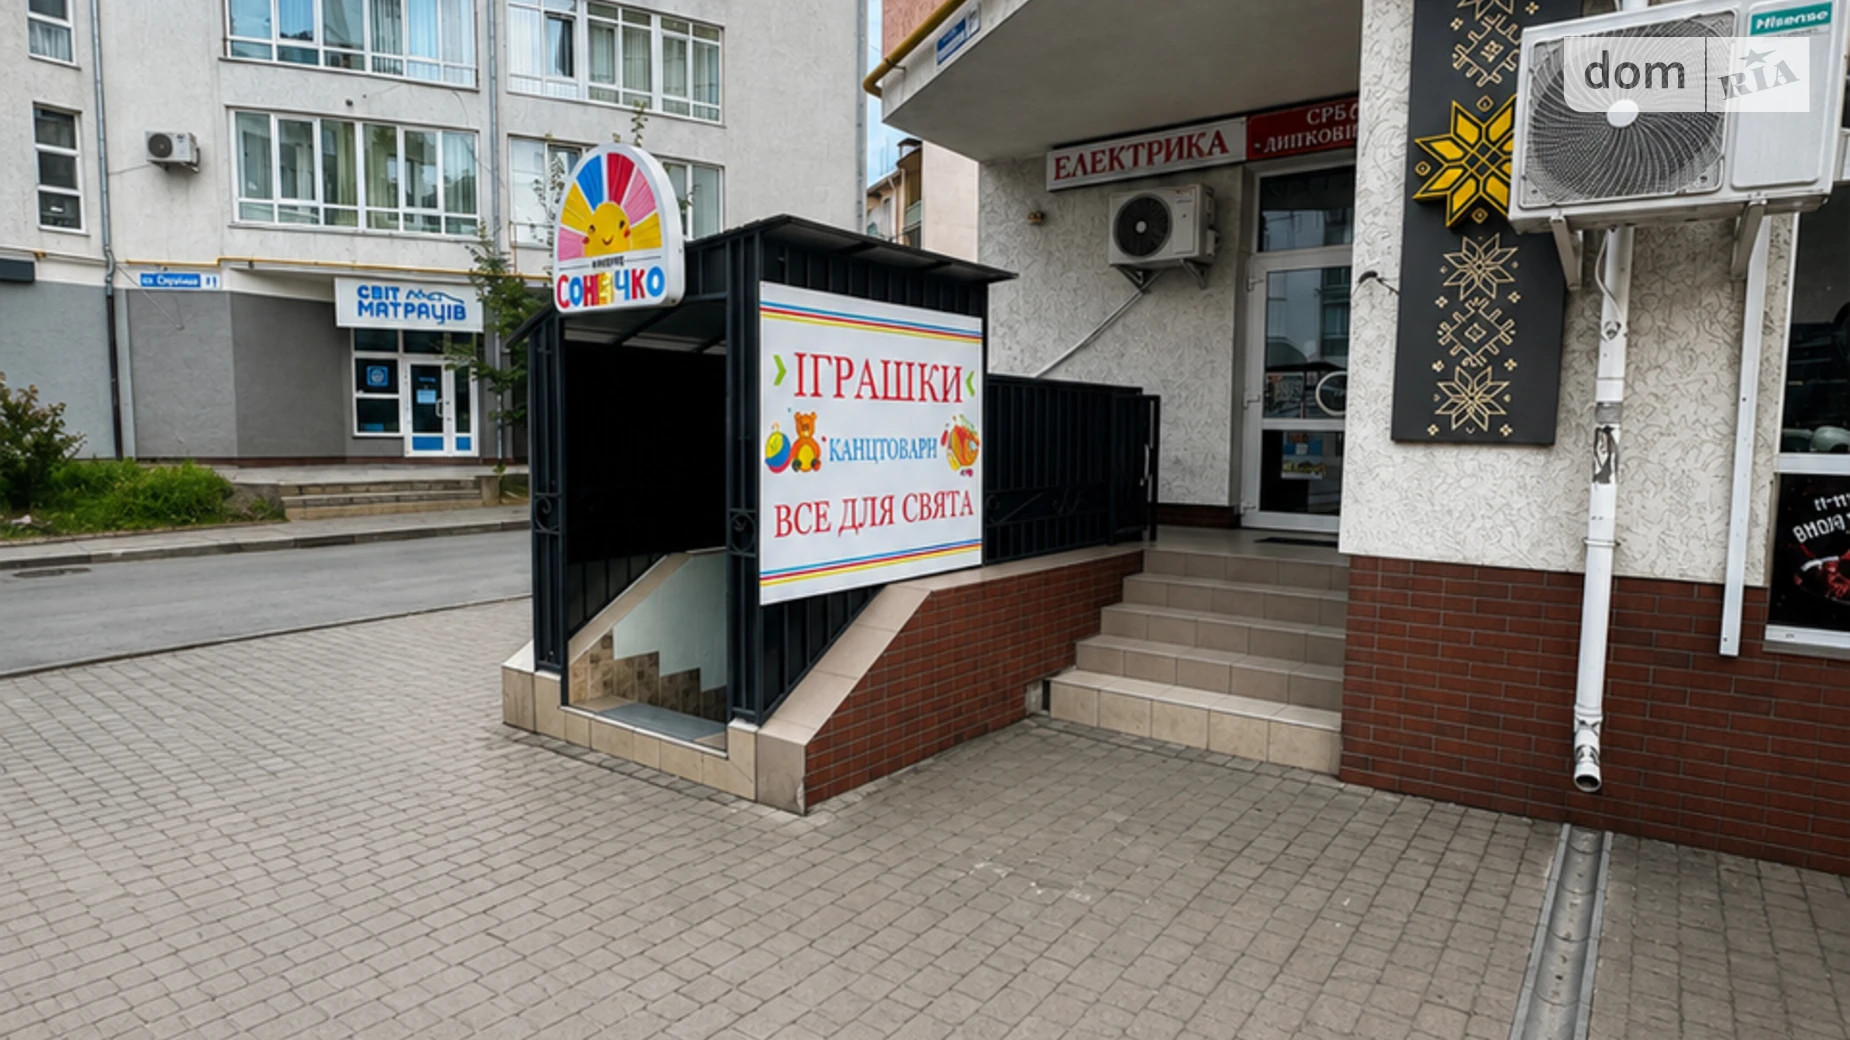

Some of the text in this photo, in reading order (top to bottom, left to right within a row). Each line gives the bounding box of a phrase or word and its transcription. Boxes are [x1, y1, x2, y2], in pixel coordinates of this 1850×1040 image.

[1755, 11, 1829, 29] Hisense
[1053, 130, 1230, 181] ЕЛЕКТРИКА
[356, 284, 400, 301] СВІТ
[556, 266, 665, 309] СОНЕЧКО
[793, 351, 964, 403] ІГРАШКИ
[829, 436, 938, 464] КАНЦТОВАРИ
[774, 489, 975, 538] ВСЕ ДЛЯ СВЯТА
